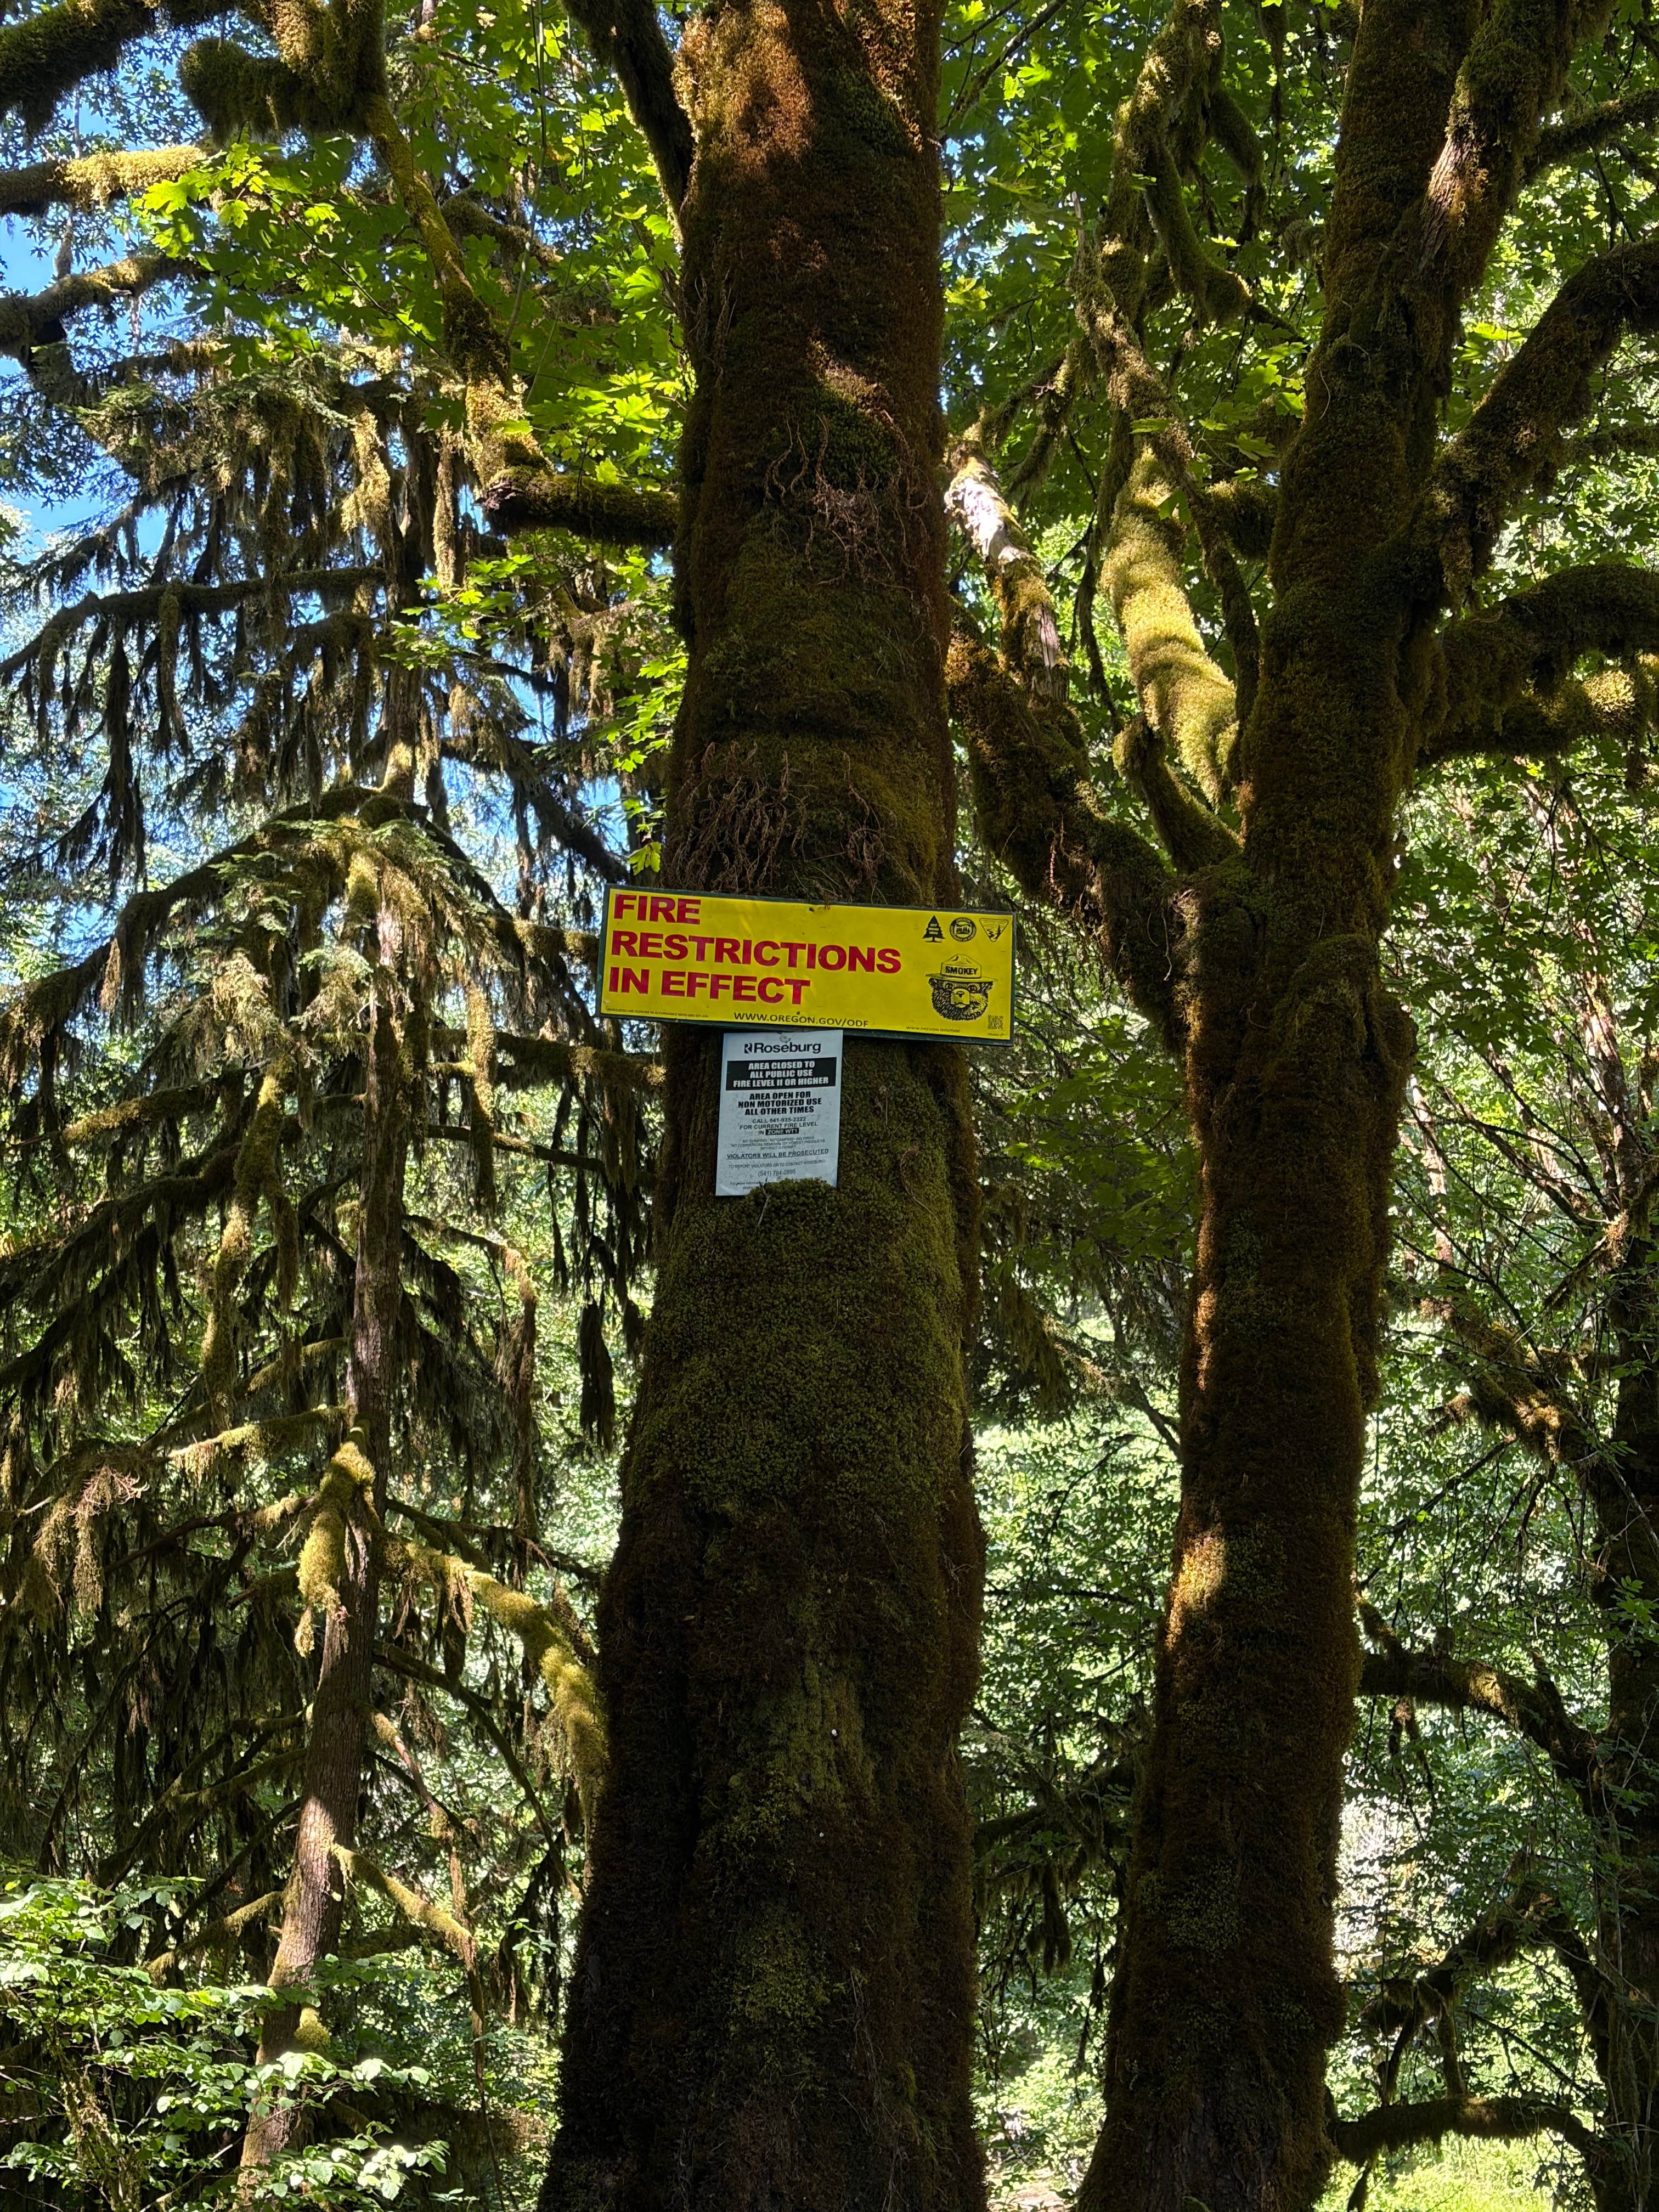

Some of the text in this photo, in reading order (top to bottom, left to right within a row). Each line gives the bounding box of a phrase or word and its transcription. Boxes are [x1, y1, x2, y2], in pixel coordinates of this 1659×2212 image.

[613, 894, 701, 925] FIRE
[611, 930, 901, 974] RESTRICTIONS
[945, 966, 978, 975] SMOKEY
[608, 967, 810, 1005] IN EFFECT
[733, 1012, 868, 1028] WWW.OREGON.GOV/ODF
[754, 1042, 821, 1054] Roseburg
[771, 1062, 803, 1070] CLOSED
[765, 1070, 795, 1078] PUBLIC
[798, 1077, 828, 1085] HIGHER
[757, 1099, 804, 1108] MOTORIZED
